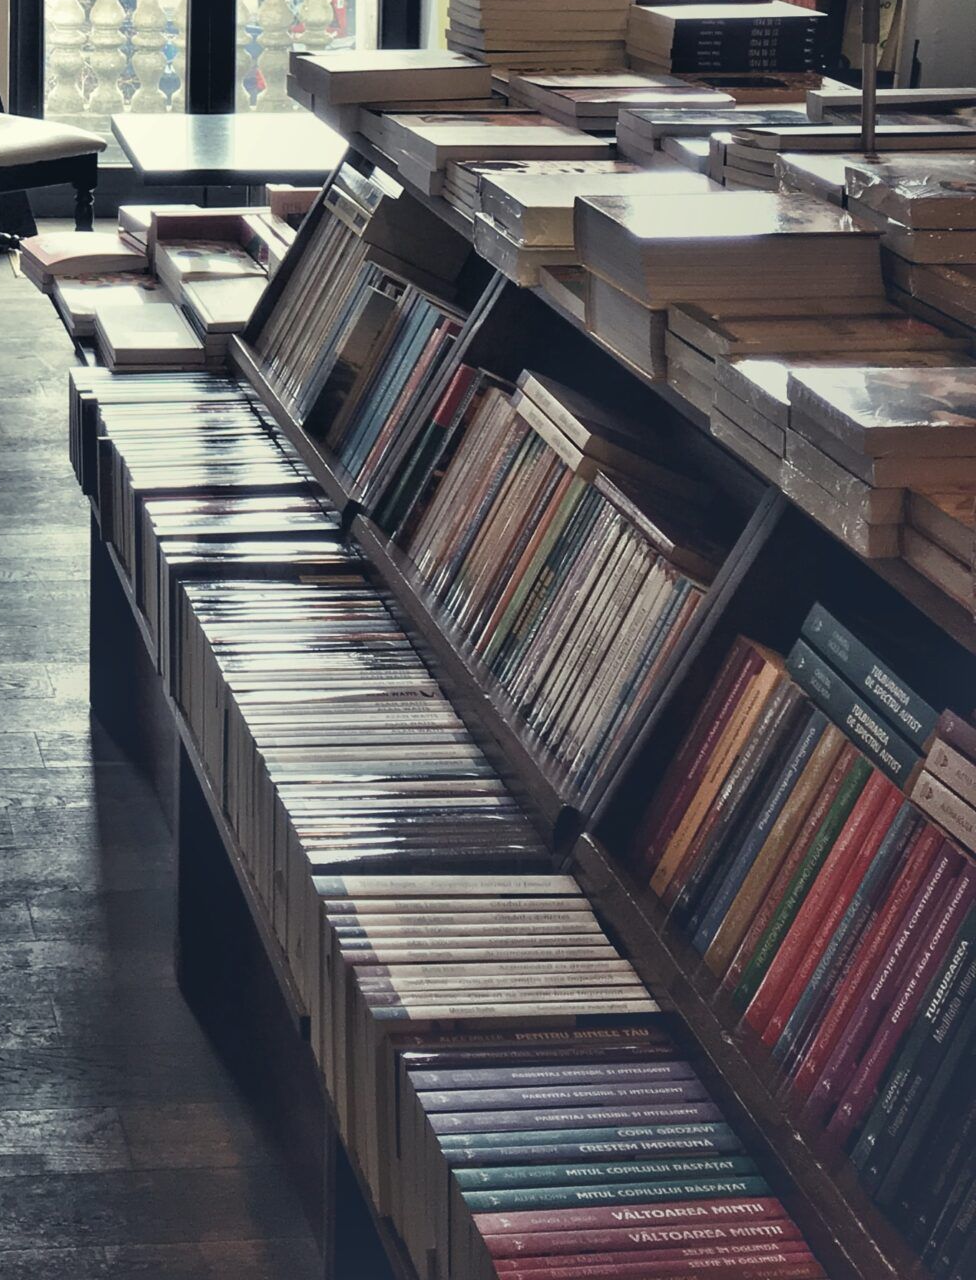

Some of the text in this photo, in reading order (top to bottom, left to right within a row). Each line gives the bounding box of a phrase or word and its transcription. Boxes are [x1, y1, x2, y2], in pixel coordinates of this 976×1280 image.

[868, 665, 912, 705] TULBURAREA
[863, 675, 922, 733] DE SPECTRU AUTIST
[848, 704, 893, 745] TULBURAREA
[844, 714, 904, 773] DE SPECTRU AUTIST
[713, 736, 760, 811] MINDFULNESS
[755, 767, 795, 831] Psihoterapie
[868, 954, 898, 1001] EDUCAȚIE
[890, 927, 912, 957] FĂRĂ
[904, 855, 951, 930] CONSTRÂNGERI
[889, 977, 920, 1024] EDUCAȚIE
[912, 950, 933, 978] FĂRĂ
[926, 876, 972, 951] CONSTRÂNGERI
[922, 939, 971, 1019] TULBURAREA
[515, 1031, 570, 1041] PENTRU
[573, 1029, 619, 1040] BINELE
[621, 1028, 649, 1038] TĂU
[511, 1070, 560, 1079] PARENTAJ
[616, 1066, 671, 1075] INTELIGENT
[521, 1092, 571, 1100] PARENTAJ
[629, 1087, 684, 1096] INTELIGENT
[534, 1114, 585, 1122] PARENTAJ
[643, 1108, 699, 1118] INTELIGENT
[617, 1124, 716, 1138] COPII GROZAVI
[565, 1167, 603, 1177] MITUL
[606, 1163, 671, 1174] COPILULUI
[576, 1190, 615, 1200] MITUL
[617, 1186, 683, 1197] COPILULUI
[611, 1202, 765, 1221] VÂLTOAREA MINȚII
[628, 1229, 726, 1244] VÂLTOAREA
[730, 1224, 784, 1239] MINȚII
[682, 1248, 715, 1257] SELFIE
[689, 1259, 723, 1268] SELFIE
